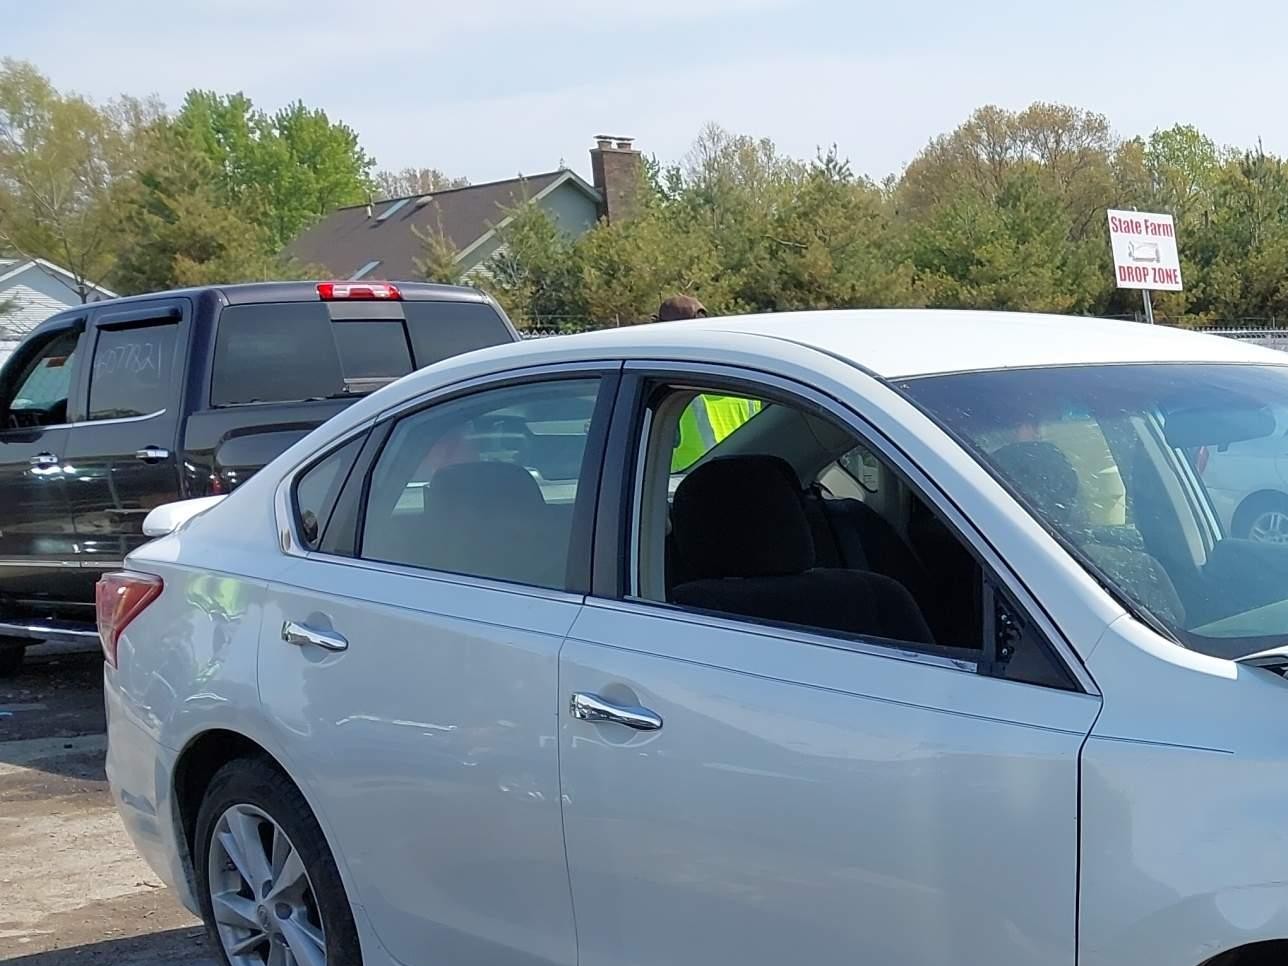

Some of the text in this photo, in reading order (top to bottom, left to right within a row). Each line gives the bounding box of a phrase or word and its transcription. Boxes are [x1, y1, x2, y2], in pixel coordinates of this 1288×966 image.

[1110, 216, 1174, 238] State Farm
[1118, 266, 1180, 285] DROP ZONE
